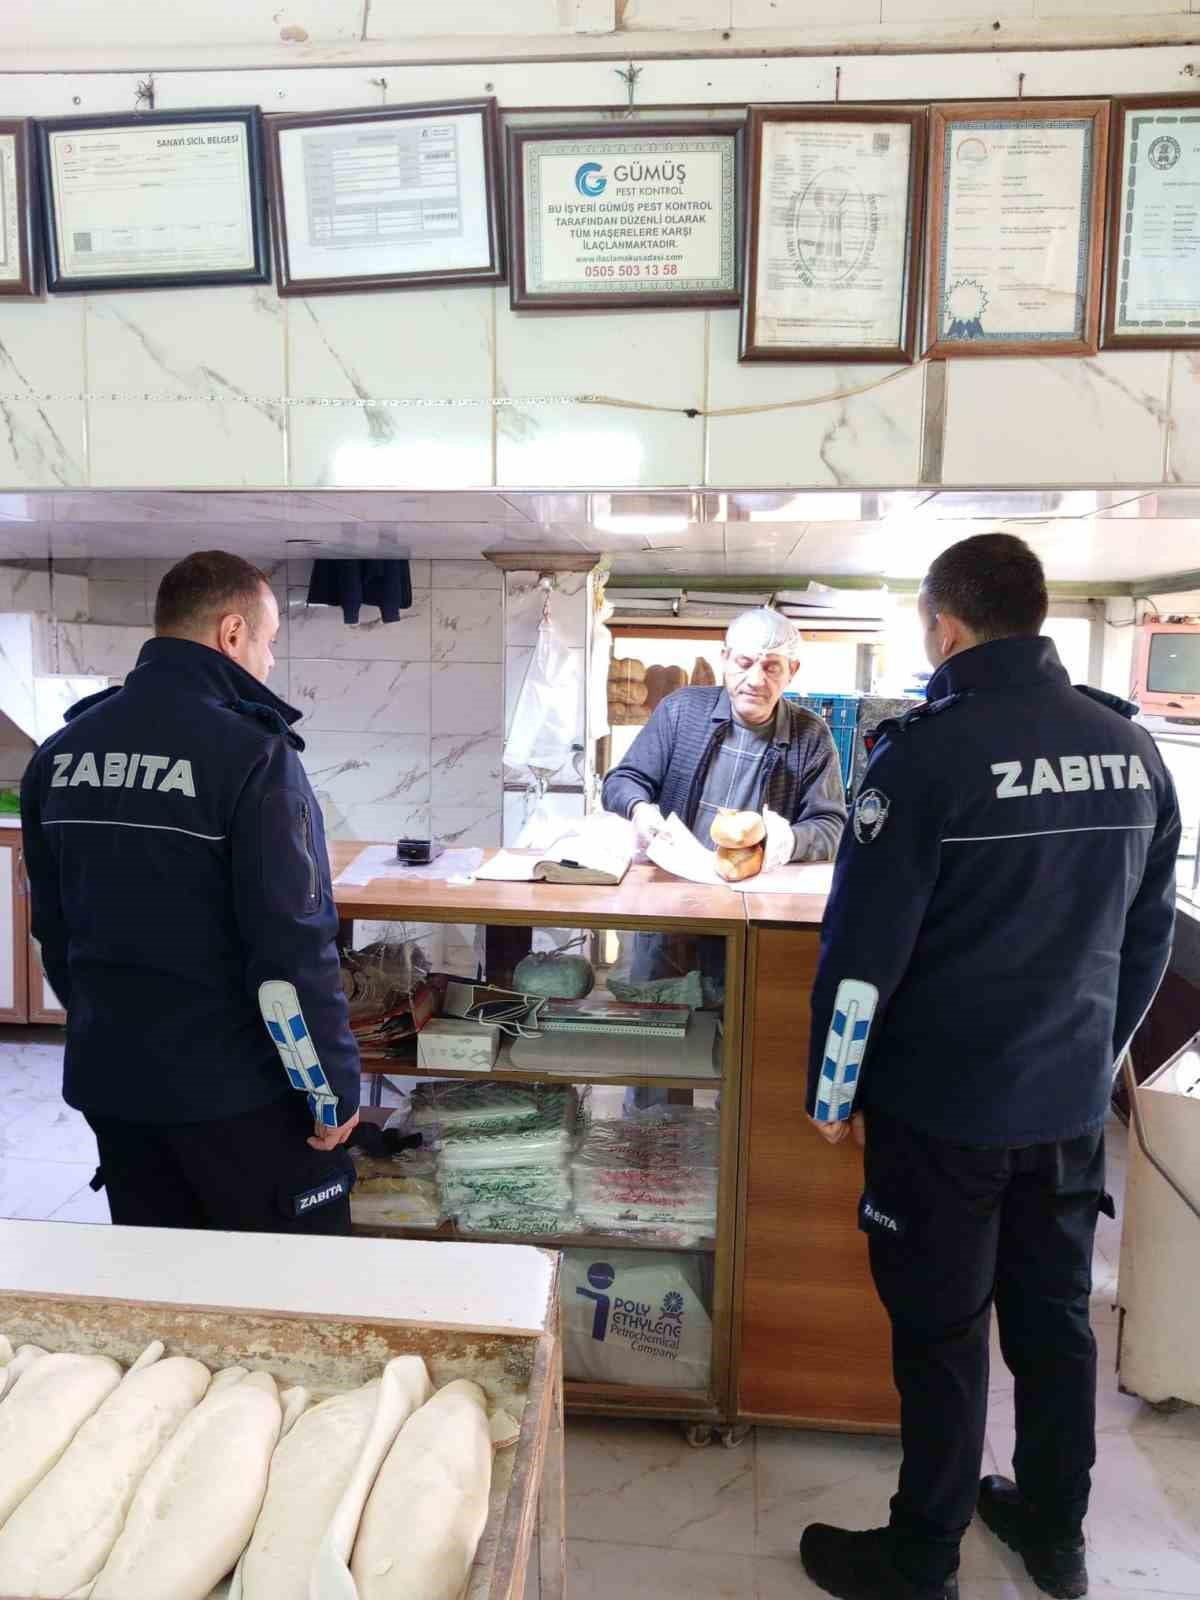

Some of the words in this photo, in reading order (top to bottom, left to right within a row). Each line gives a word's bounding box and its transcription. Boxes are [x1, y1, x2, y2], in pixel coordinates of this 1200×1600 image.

[614, 161, 686, 184] GÜMÜŞ
[616, 187, 637, 196] PEST
[640, 186, 683, 196] KONTROL
[548, 205, 562, 213] BU
[565, 204, 597, 214] İŞYERİ
[599, 203, 635, 213] GÜMÜŞ
[638, 202, 662, 210] PEST
[665, 201, 713, 210] KONTROL
[556, 217, 618, 226] TARAFINDAN
[620, 215, 663, 225] DÜZENLİ
[665, 214, 706, 224] OLARAK
[570, 230, 591, 238] TÜM
[593, 228, 659, 238] HAŞERELERE
[662, 227, 692, 237] KARŞI
[583, 239, 679, 251] İLAÇLANMAKTADIR.
[585, 266, 614, 277] 0505
[618, 266, 641, 276] 503
[645, 265, 659, 275] 13
[663, 264, 678, 275] 58
[51, 752, 196, 797] ZABITA
[990, 755, 1151, 799] ZABITA
[300, 1184, 343, 1209] ZABITA
[614, 1297, 651, 1317] POLY
[610, 1323, 680, 1350] Petrochemical
[630, 1340, 679, 1360] Company
